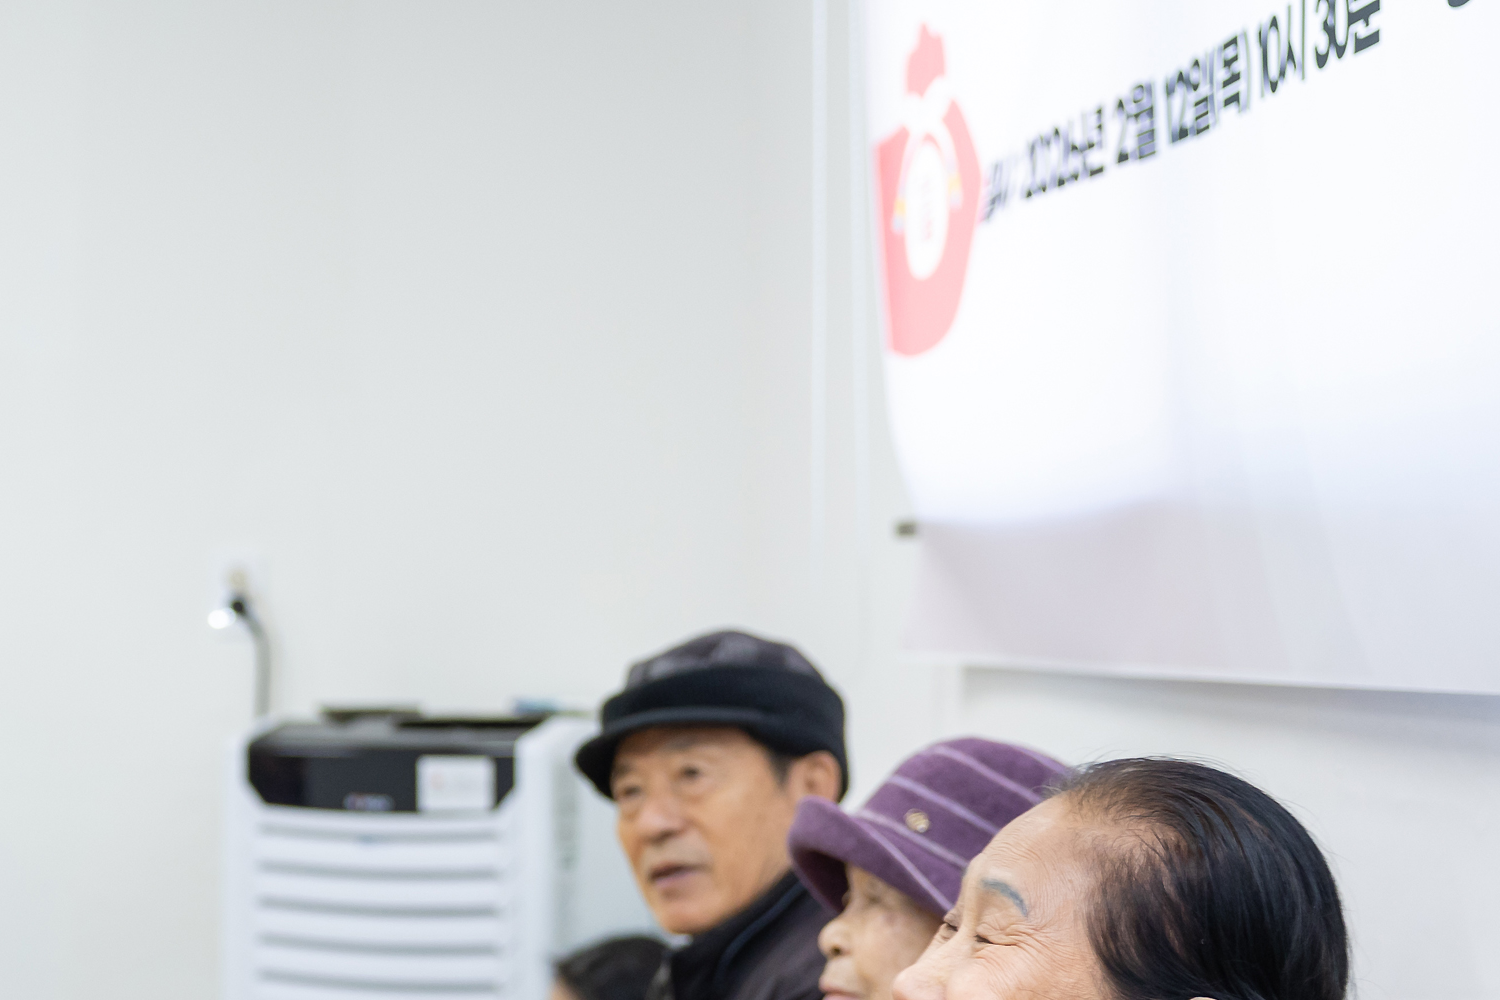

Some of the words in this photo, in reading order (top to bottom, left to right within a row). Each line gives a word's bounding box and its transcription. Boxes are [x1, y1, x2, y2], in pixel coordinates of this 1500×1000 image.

[1021, 104, 1104, 199] 2026년
[1113, 80, 1157, 165] 2월
[1164, 30, 1251, 145] 12일(목)
[1258, 0, 1306, 98] 10시
